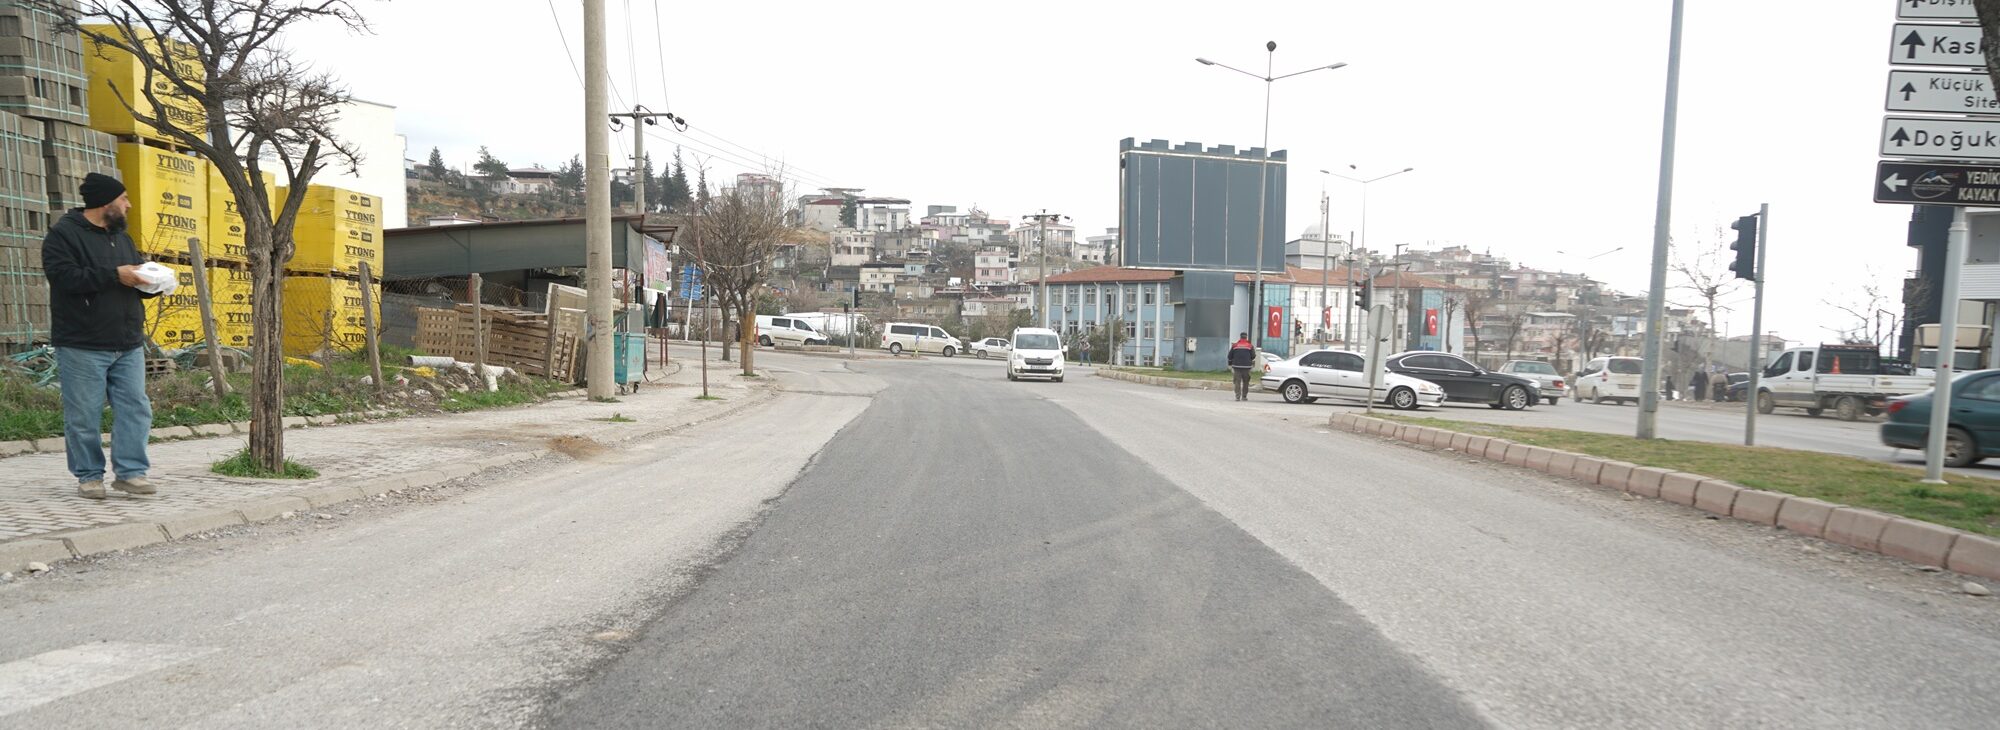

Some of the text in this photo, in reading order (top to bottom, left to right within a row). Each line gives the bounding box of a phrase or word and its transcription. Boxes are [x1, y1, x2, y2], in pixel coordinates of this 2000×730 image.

[1929, 77, 1984, 92] Küçük
[1964, 96, 2000, 108] Site
[1914, 130, 2000, 151] Doğuk
[156, 154, 195, 172] YTONG
[1957, 188, 1996, 201] KAYAK
[156, 212, 196, 230] YTONG
[345, 209, 375, 223] YTONG
[223, 243, 248, 256] YTO
[344, 244, 375, 258] YTONG
[226, 312, 253, 323] YTO
